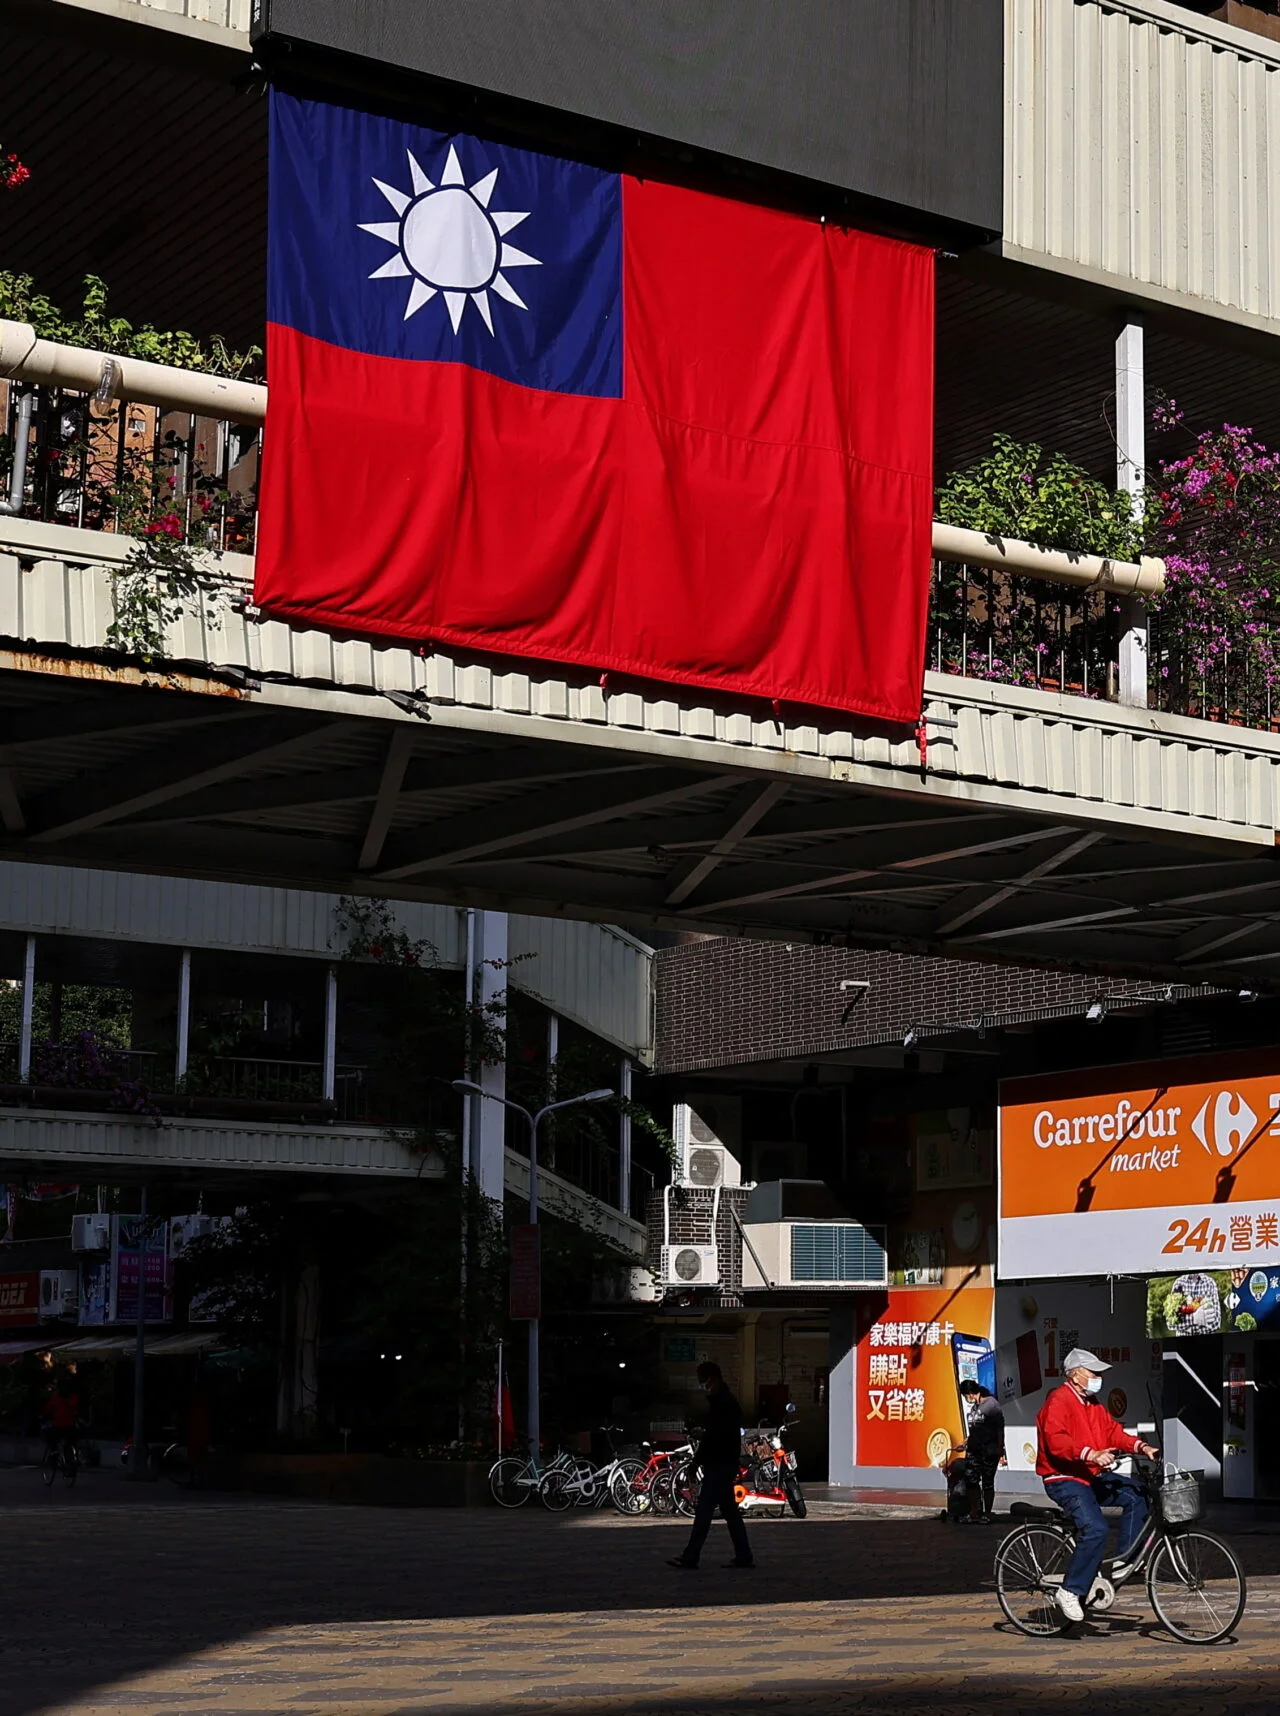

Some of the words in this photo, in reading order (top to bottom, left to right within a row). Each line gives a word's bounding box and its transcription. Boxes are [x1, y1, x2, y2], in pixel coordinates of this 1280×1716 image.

[1033, 1099, 1182, 1148] Carrefour
[1109, 1144, 1181, 1173] market
[1160, 1211, 1280, 1255] 24h營業
[869, 1320, 956, 1347] 家樂福好康卡
[868, 1353, 908, 1386] 賺點
[866, 1387, 925, 1422] 又省錢
